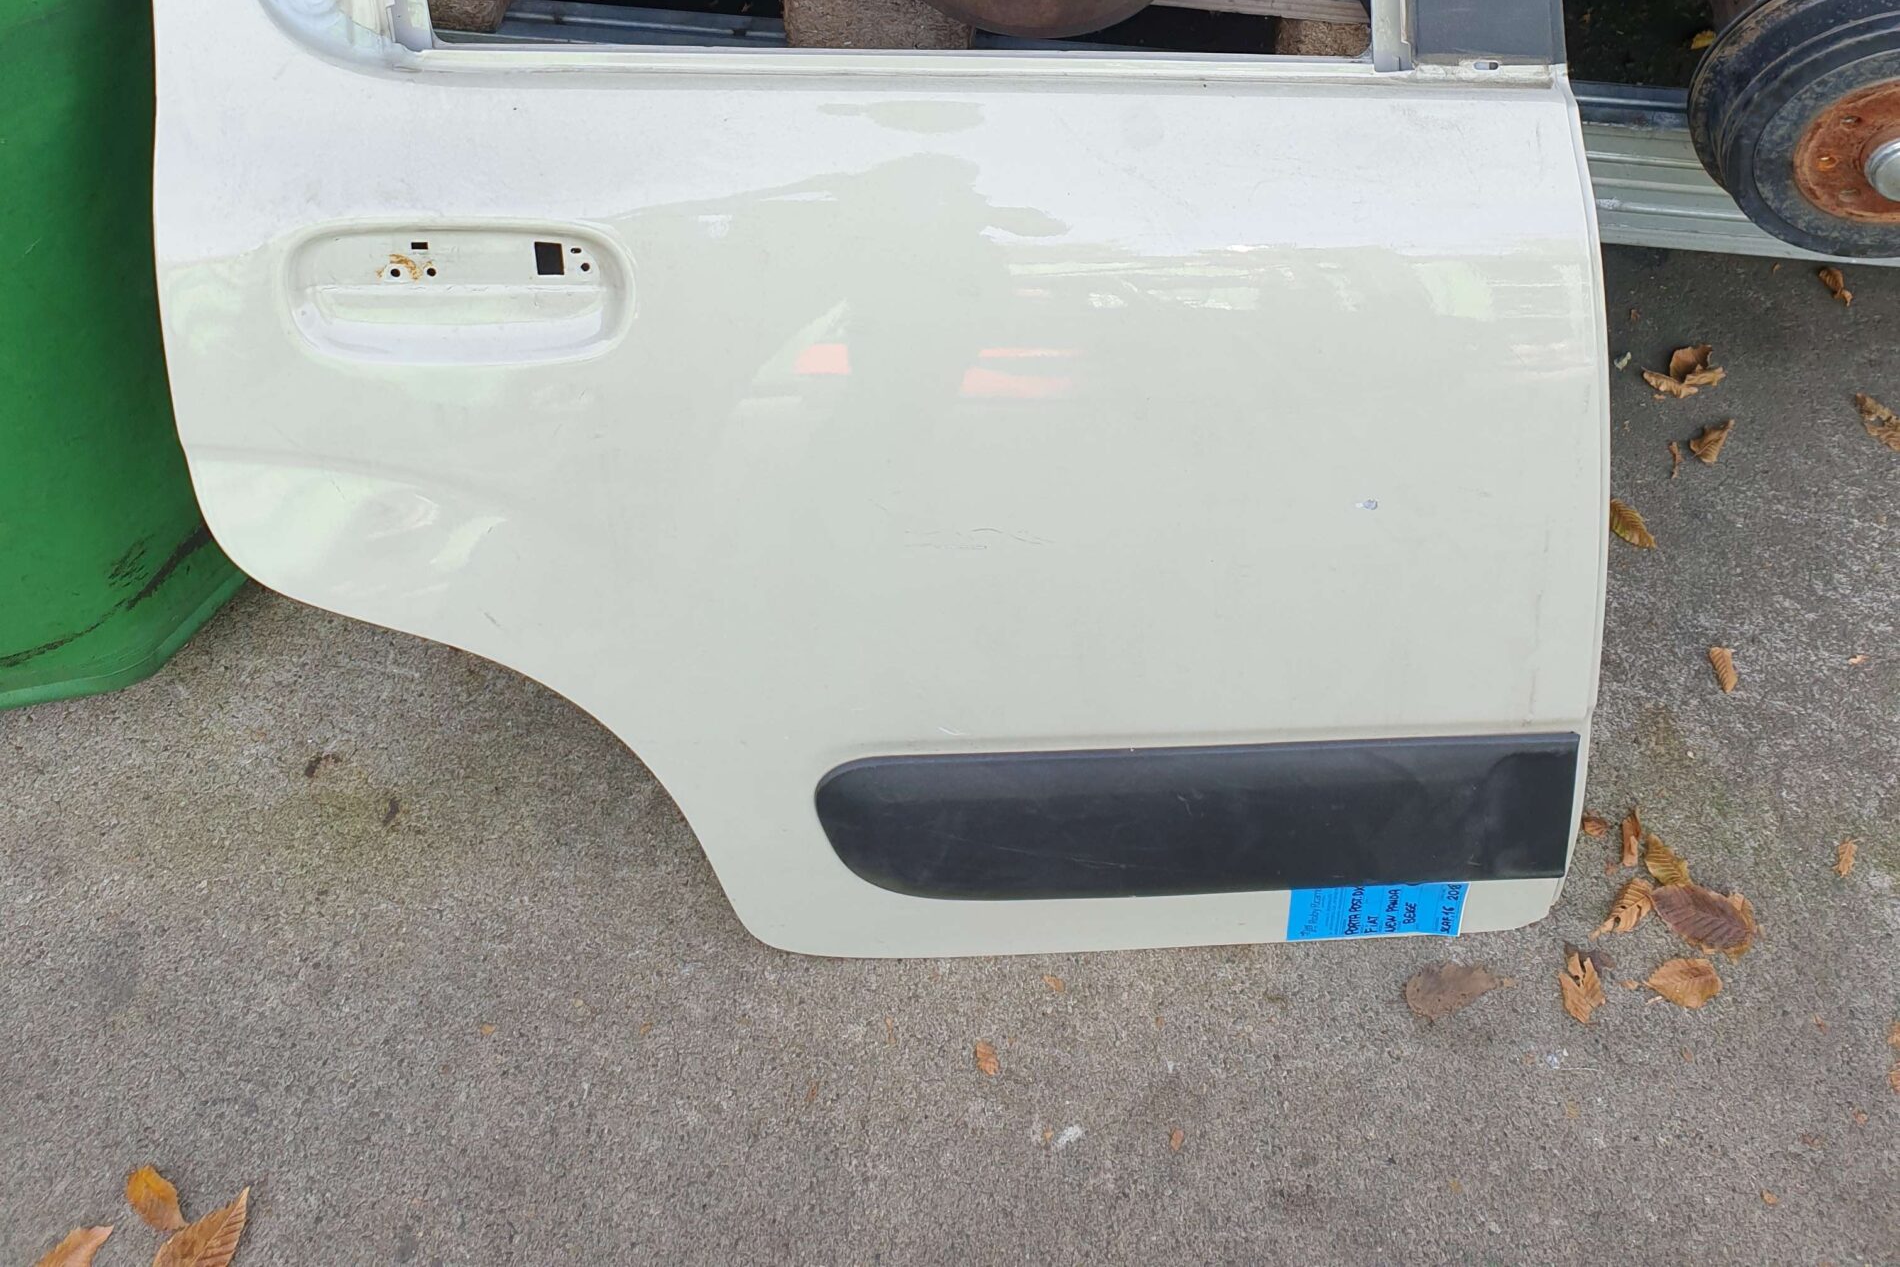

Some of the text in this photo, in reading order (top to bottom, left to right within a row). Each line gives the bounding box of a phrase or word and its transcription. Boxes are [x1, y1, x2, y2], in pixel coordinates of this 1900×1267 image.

[1384, 888, 1402, 933] NEW PANDA
[1402, 902, 1417, 925] BEIGE
[1344, 911, 1361, 935] PORTA
